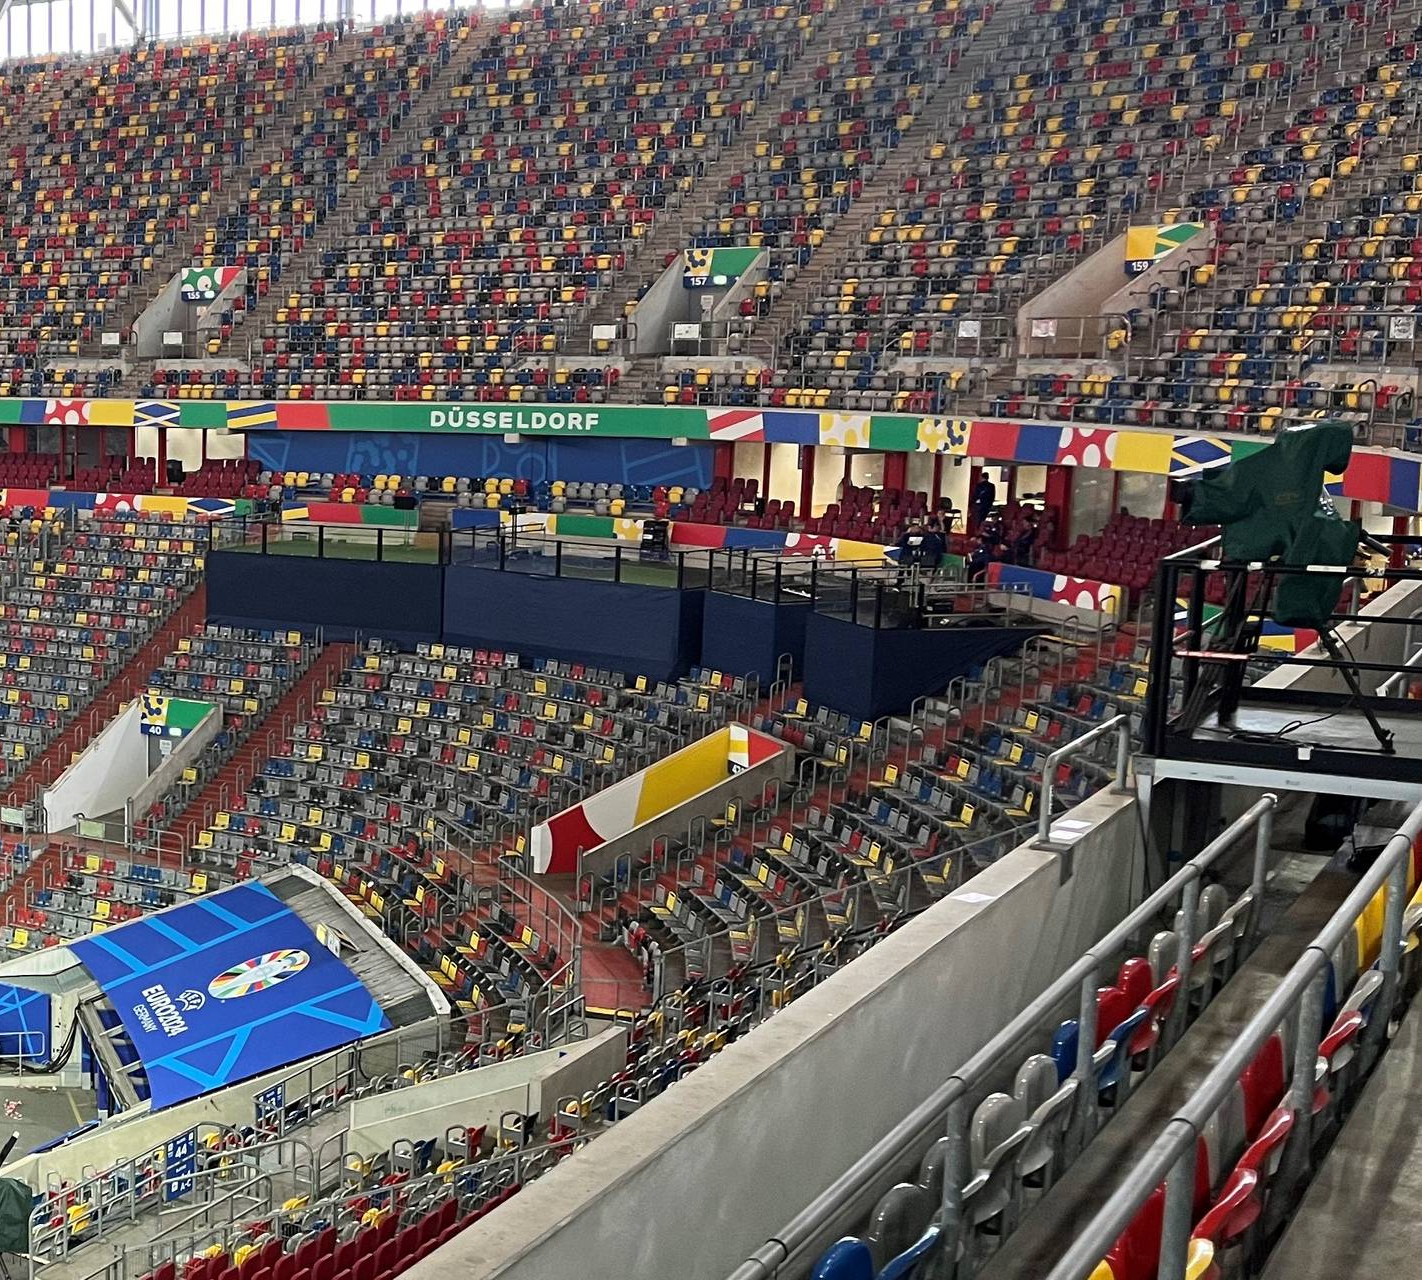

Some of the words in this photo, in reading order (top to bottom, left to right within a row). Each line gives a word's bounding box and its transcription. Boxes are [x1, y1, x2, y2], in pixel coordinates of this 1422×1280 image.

[1131, 261, 1149, 272] 159
[690, 277, 707, 286] 157
[187, 291, 201, 299] 155
[430, 406, 599, 430] DÜSSELDORF
[149, 726, 162, 735] 40
[141, 984, 189, 1038] EURO2024
[132, 1004, 159, 1033] GERMANY
[175, 1143, 188, 1159] 44
